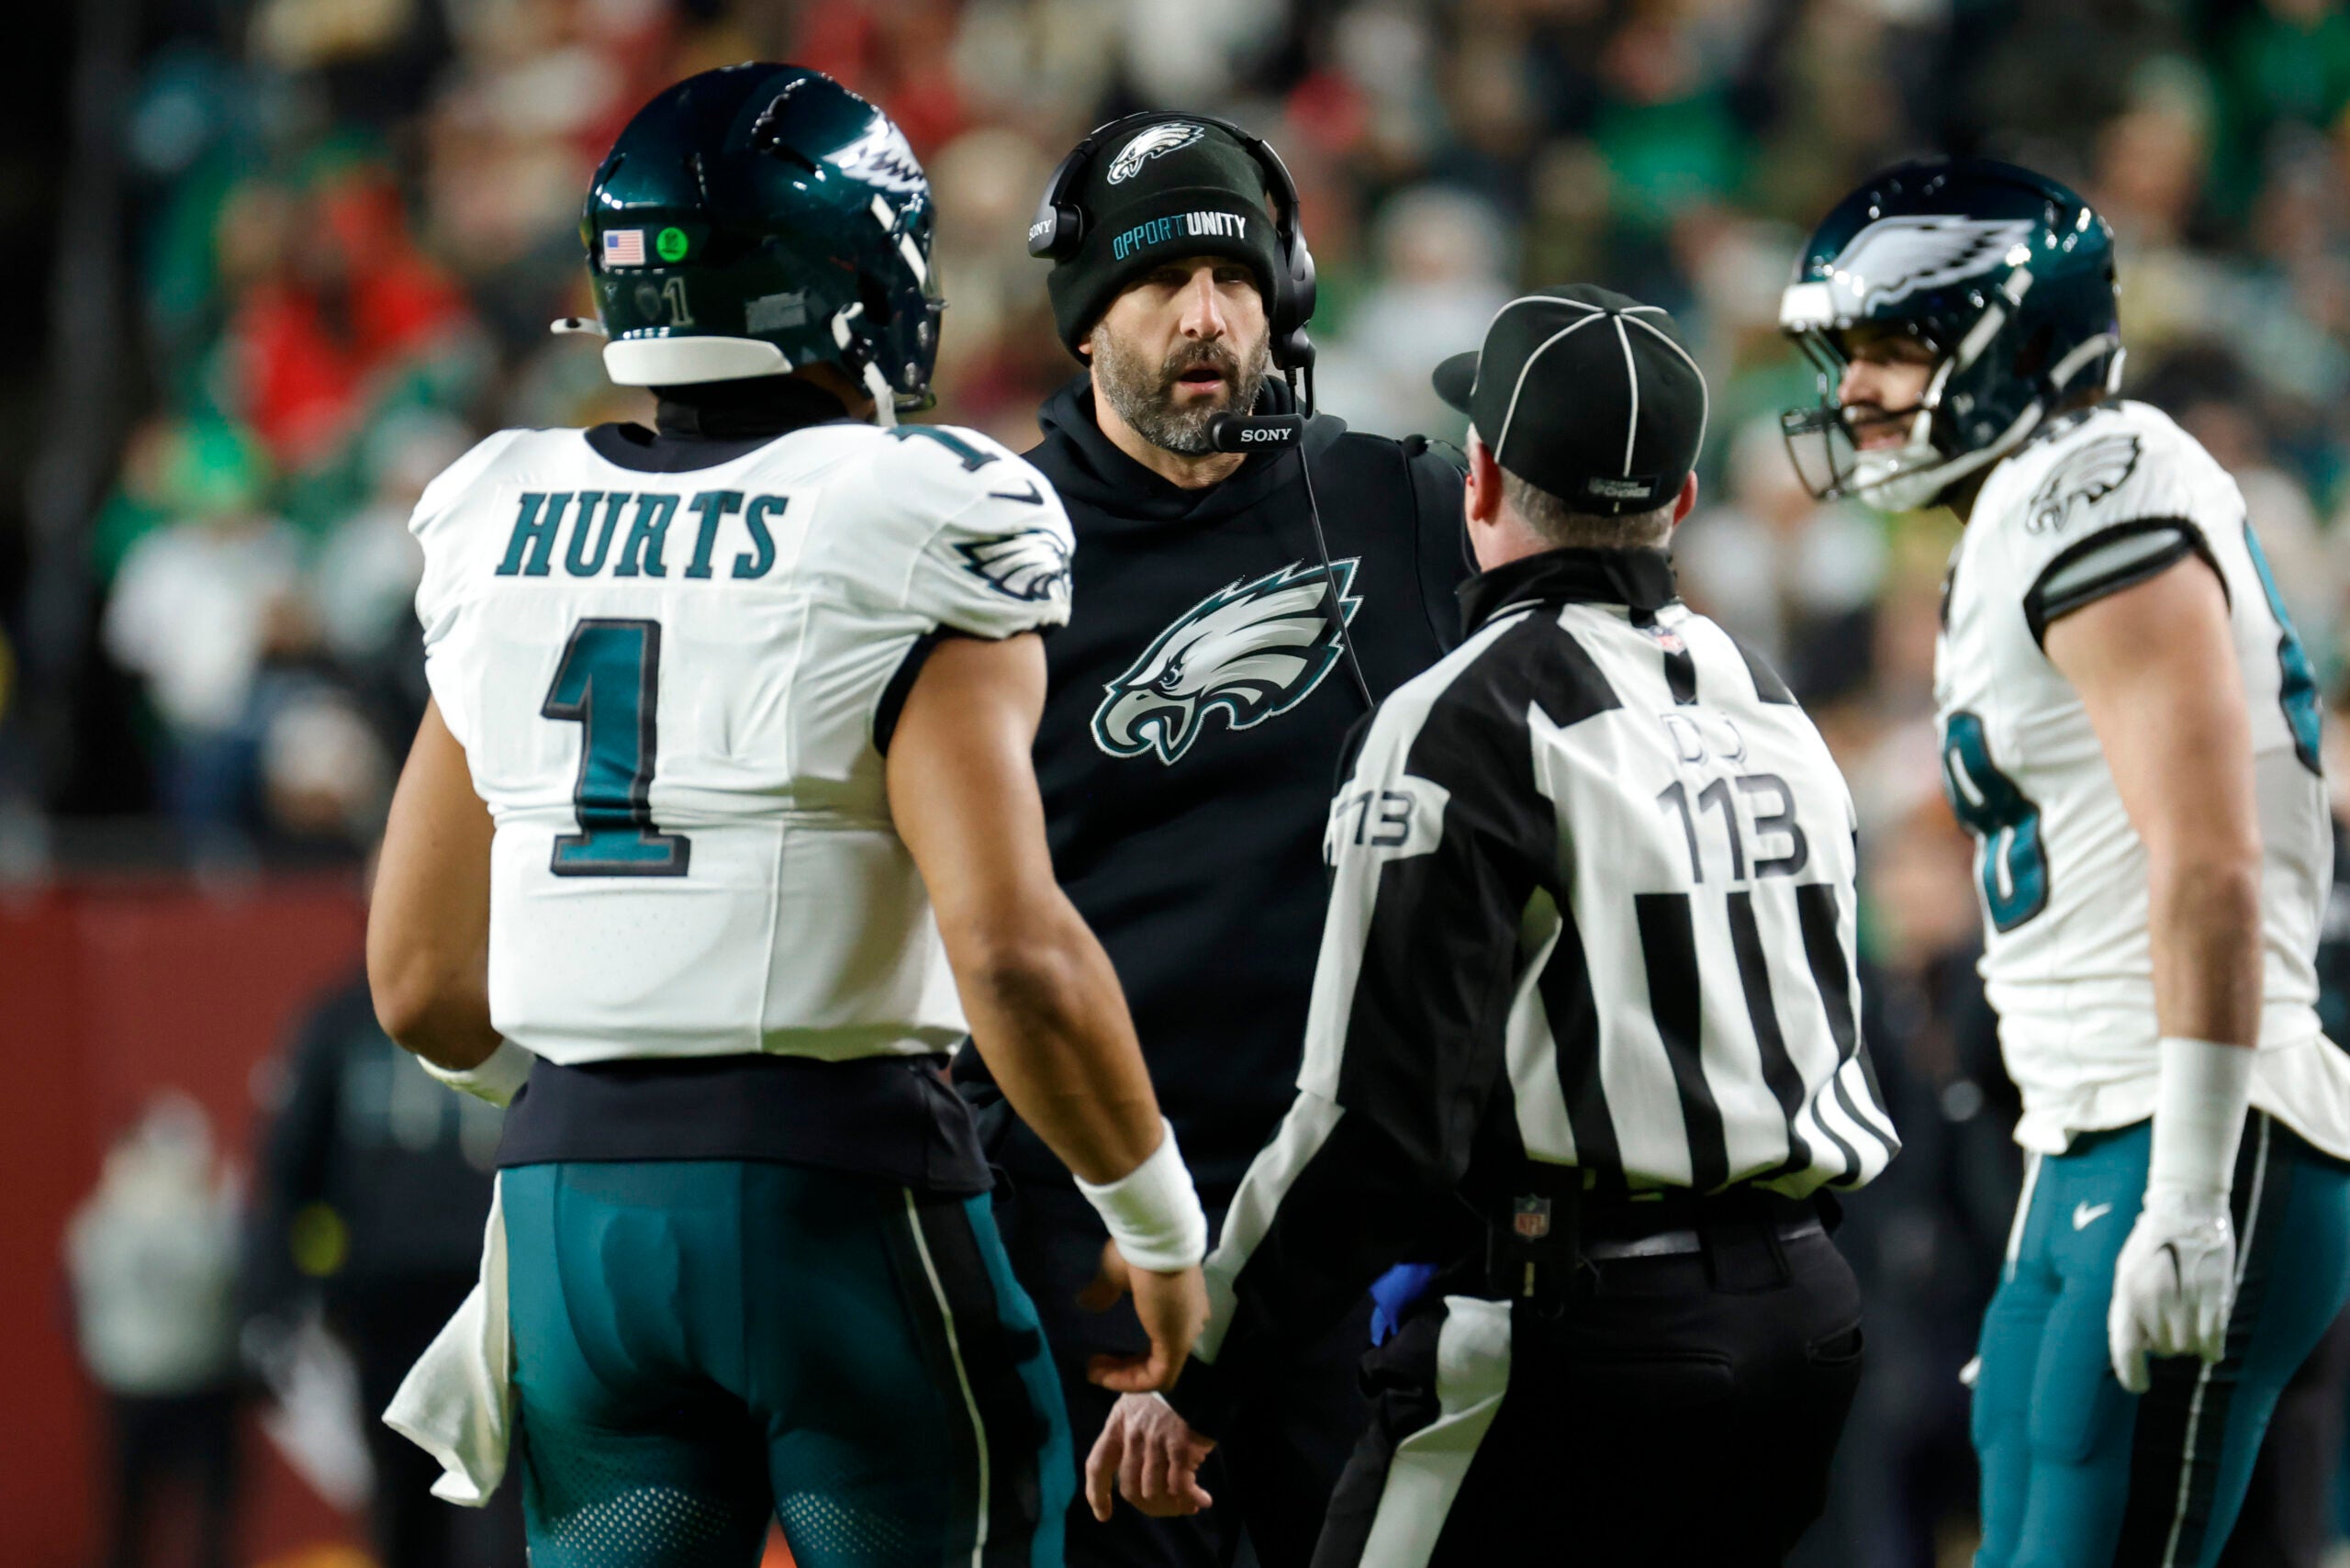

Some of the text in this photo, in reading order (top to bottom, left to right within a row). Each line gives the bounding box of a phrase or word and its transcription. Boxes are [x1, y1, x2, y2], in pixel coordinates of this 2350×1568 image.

[1113, 211, 1247, 261] OPPORTUNITY
[662, 277, 696, 326] 1
[1240, 428, 1292, 442] SONY
[496, 489, 789, 580] HURTS
[541, 618, 691, 878] 1
[1656, 773, 1808, 883] 113
